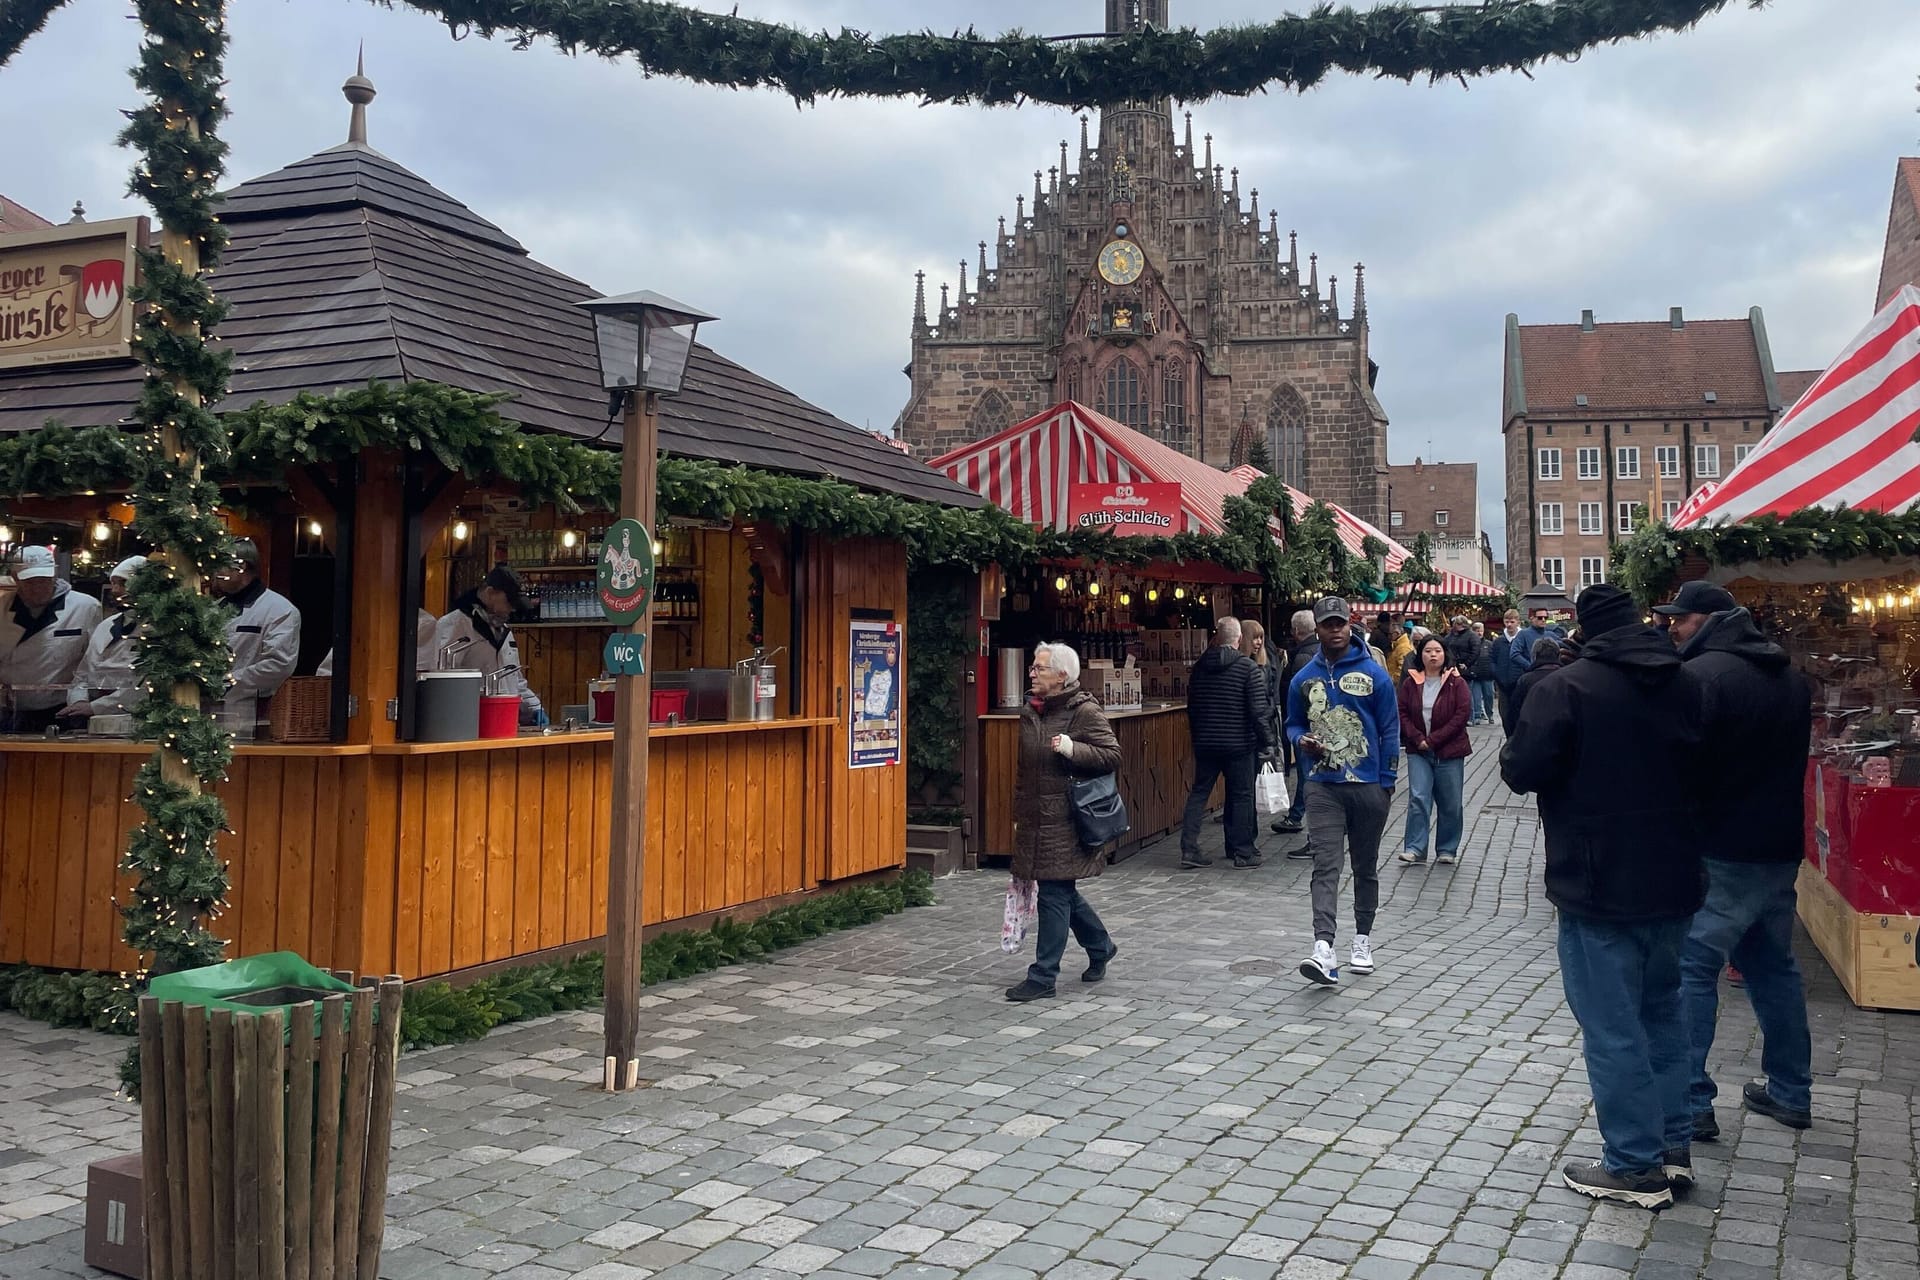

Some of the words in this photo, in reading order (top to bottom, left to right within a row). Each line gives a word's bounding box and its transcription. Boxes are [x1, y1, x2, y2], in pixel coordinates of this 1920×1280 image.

[0, 265, 46, 294] rger
[1079, 508, 1171, 528] Glüh-Schlehe
[613, 646, 634, 661] WC
